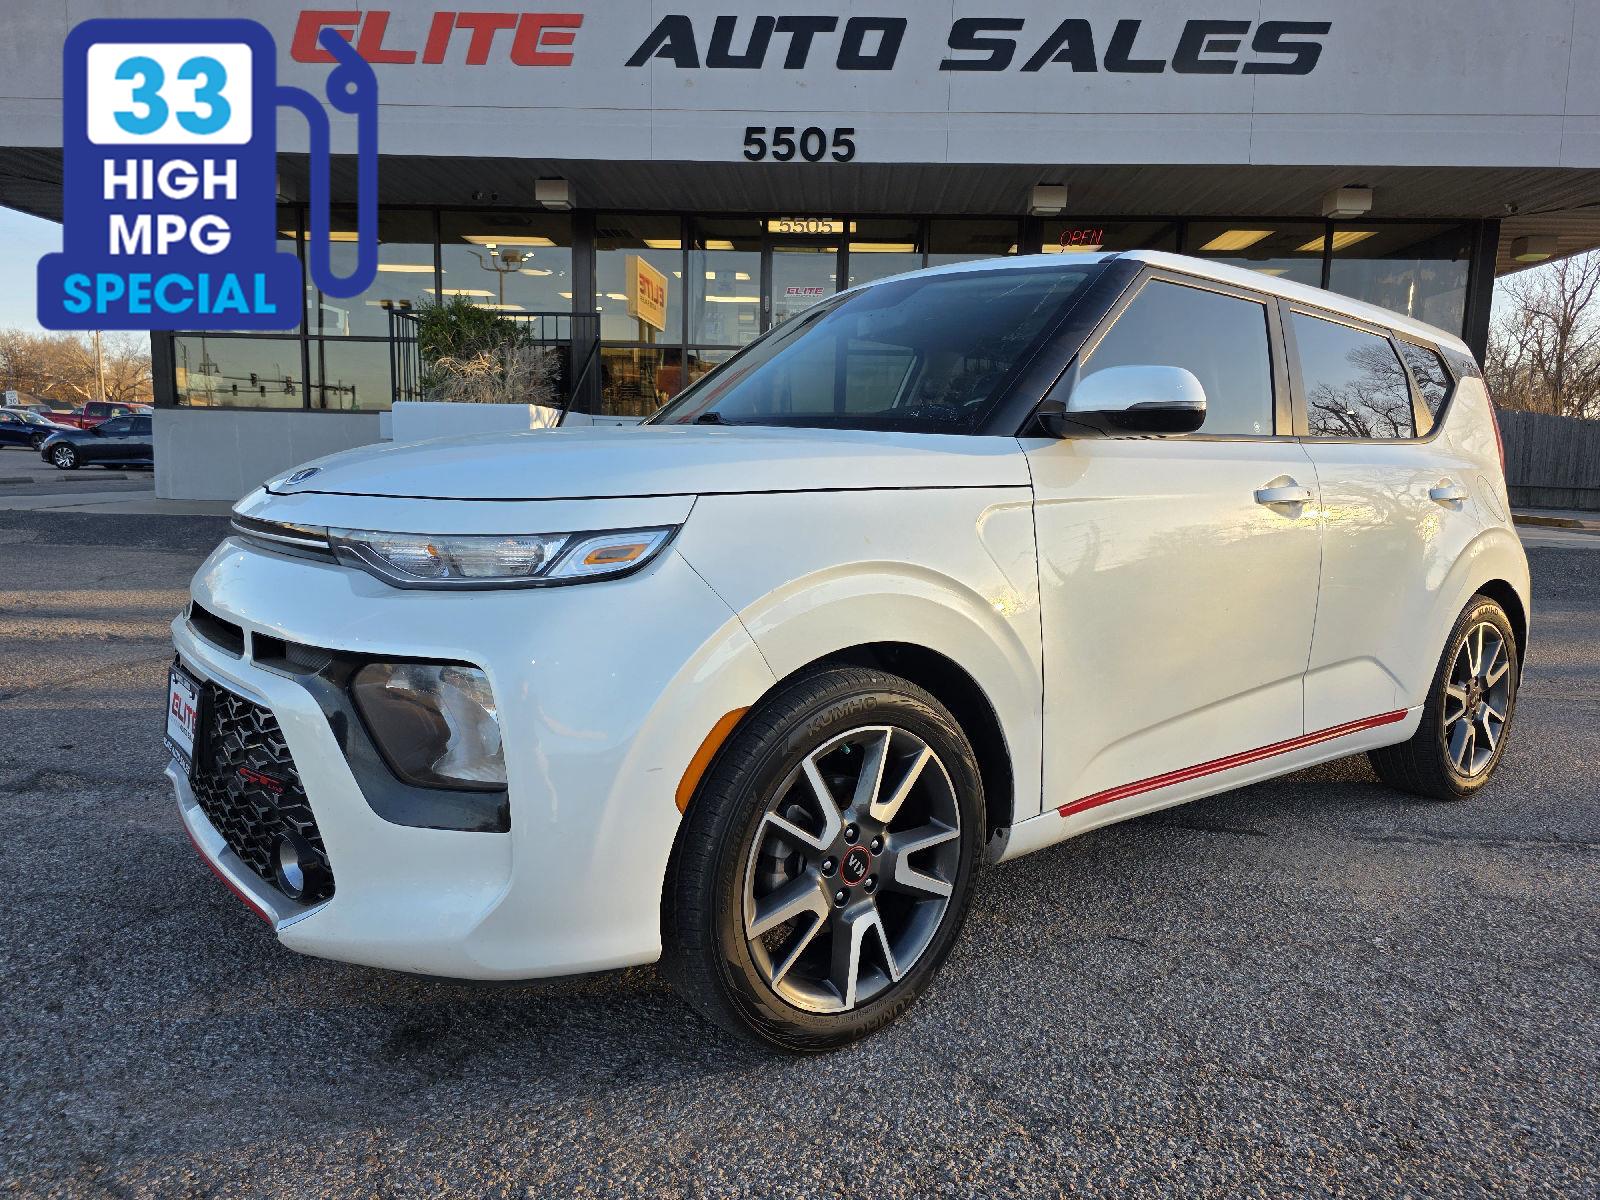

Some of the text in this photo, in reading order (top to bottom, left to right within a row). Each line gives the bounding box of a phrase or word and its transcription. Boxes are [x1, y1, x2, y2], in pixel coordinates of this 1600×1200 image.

[291, 11, 1332, 75] ELITE AUTO SALES
[743, 126, 856, 163] 5505
[780, 217, 832, 234] 5505
[1060, 229, 1103, 247] OPEN
[786, 287, 824, 295] ELITE
[806, 696, 878, 737] KUMHO
